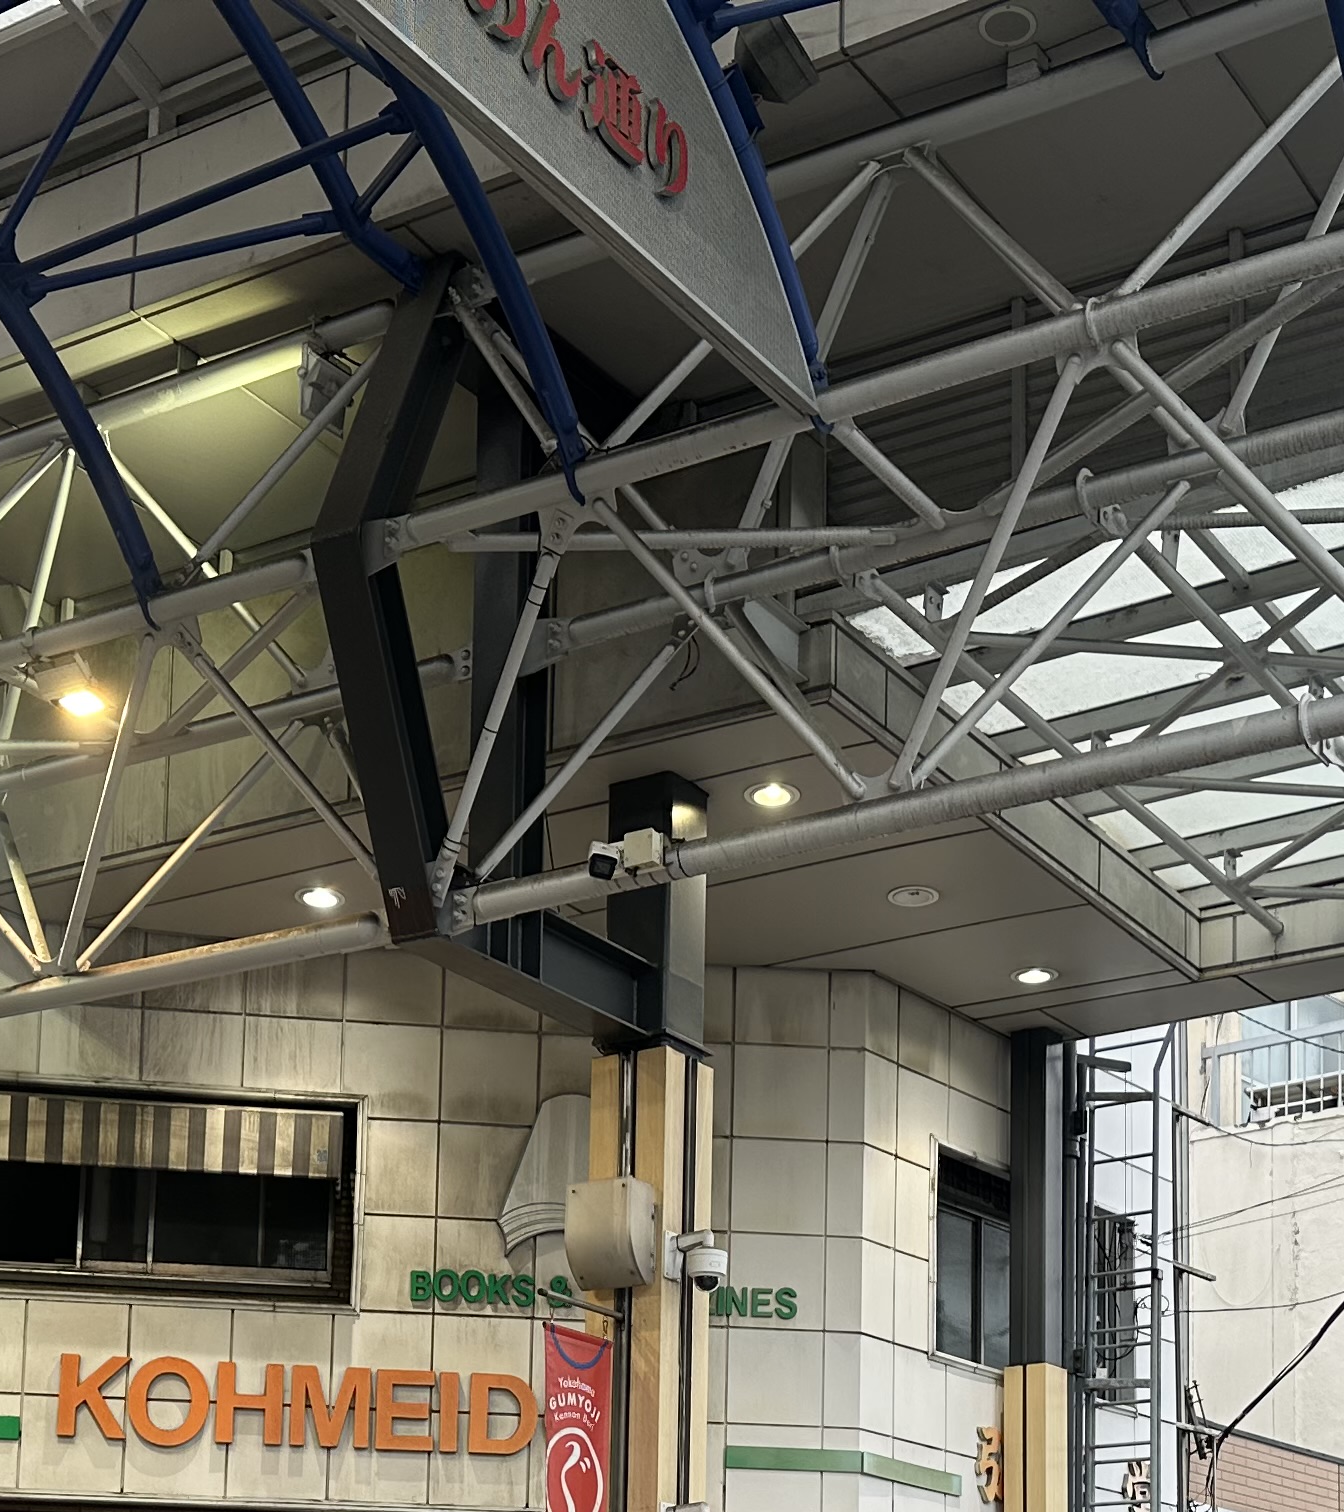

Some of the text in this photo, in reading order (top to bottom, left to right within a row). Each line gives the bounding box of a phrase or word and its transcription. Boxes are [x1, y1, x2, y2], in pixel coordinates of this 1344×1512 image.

[410, 1268, 536, 1307] BOOKS
[56, 1353, 543, 1456] KOHMEID
[549, 1391, 601, 1424] GUMYOJI
